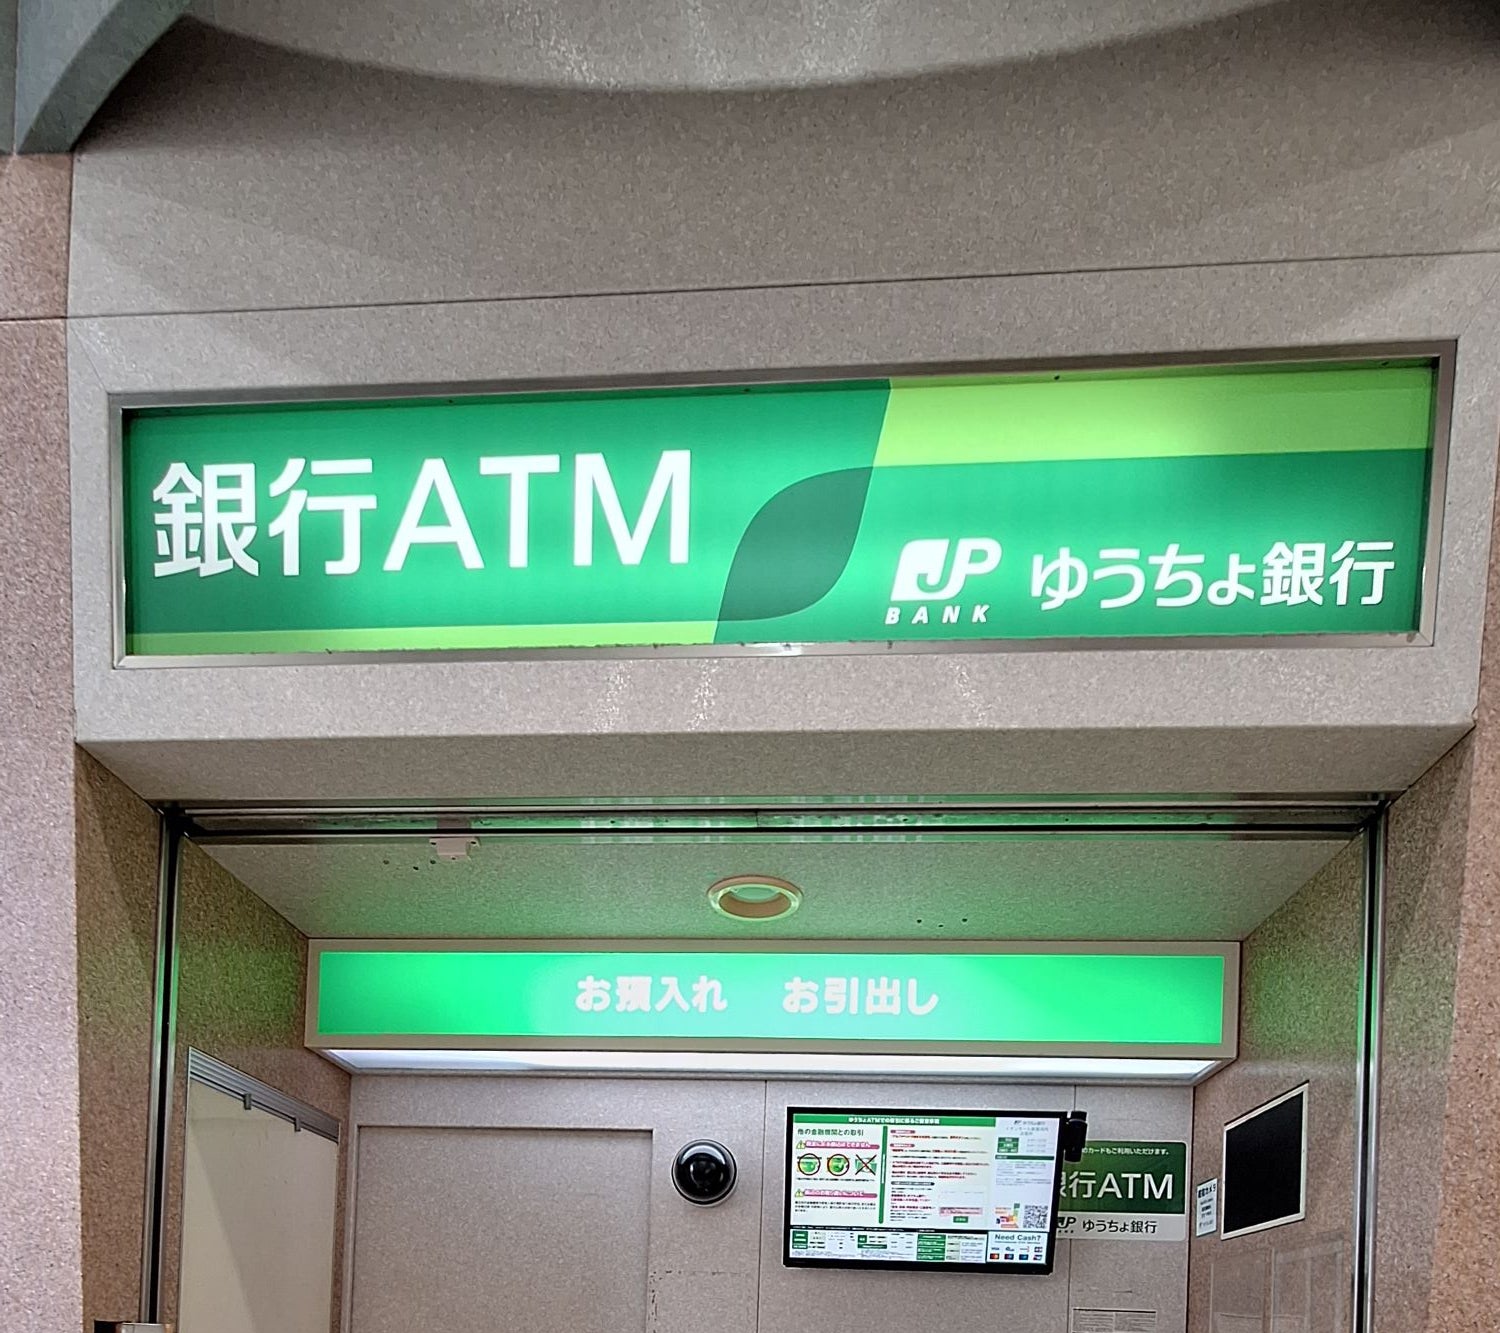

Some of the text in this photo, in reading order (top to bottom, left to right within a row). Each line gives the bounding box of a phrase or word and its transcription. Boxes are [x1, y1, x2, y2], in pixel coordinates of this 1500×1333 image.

[152, 449, 692, 578] 銀行ATM
[1030, 540, 1395, 611] ゆうちょ銀行
[884, 604, 991, 625] BANK
[575, 975, 939, 1015] お預入れ お引出し
[1082, 1219, 1157, 1233] ゆうちょ銀行
